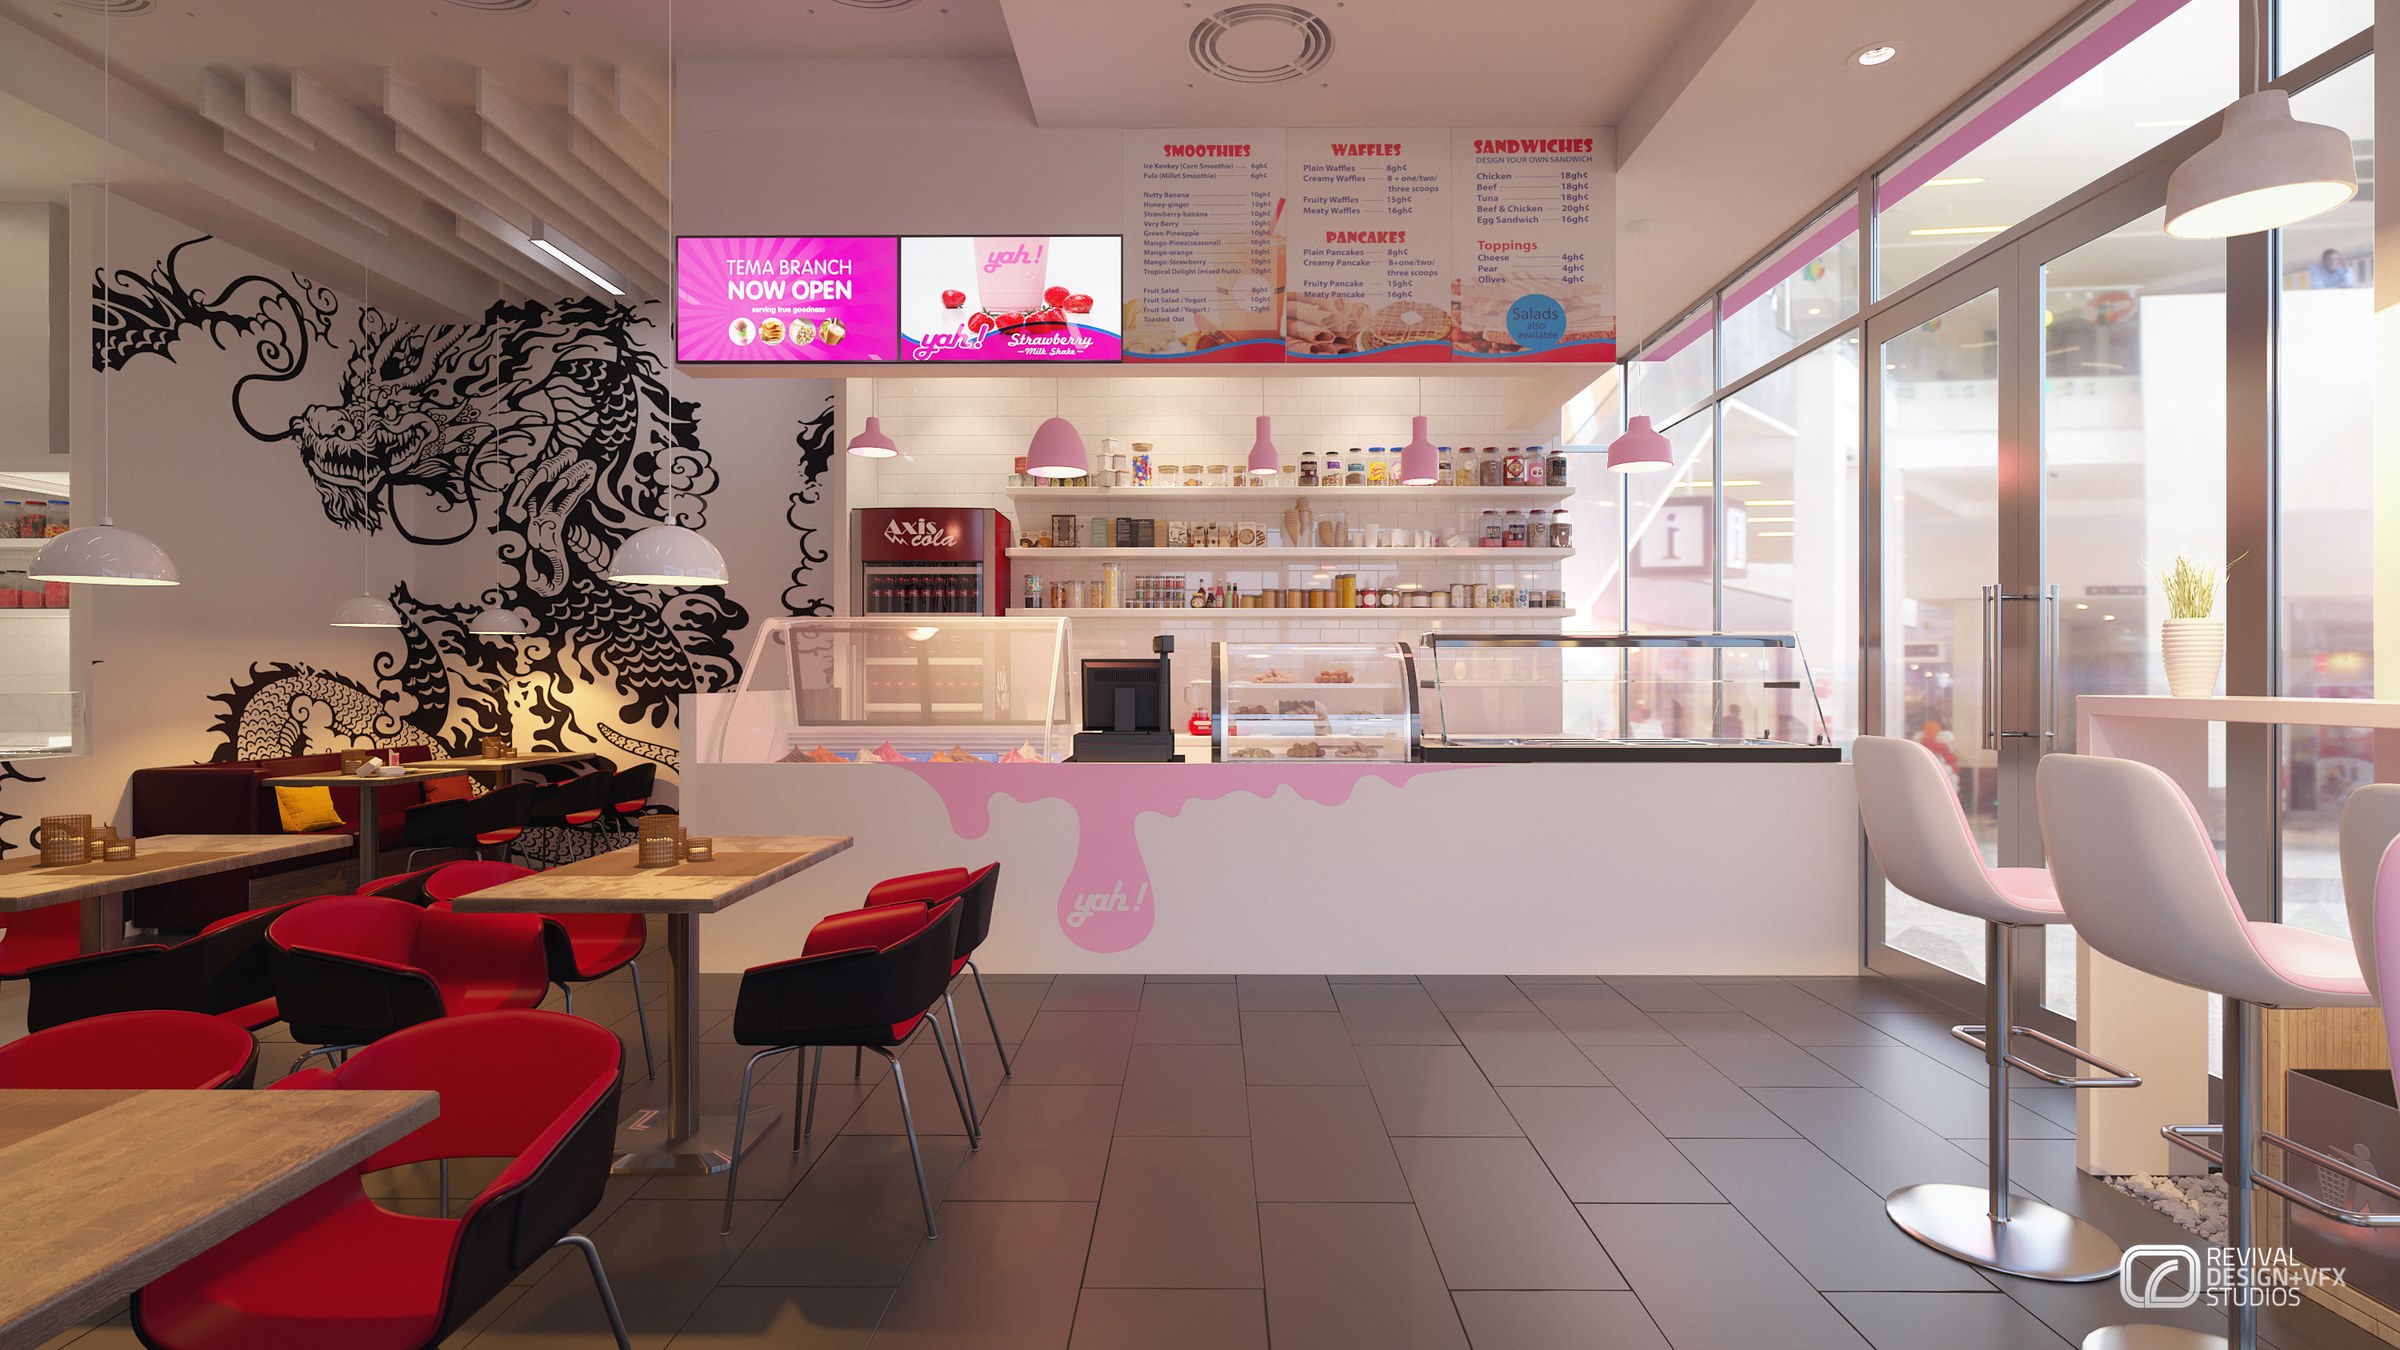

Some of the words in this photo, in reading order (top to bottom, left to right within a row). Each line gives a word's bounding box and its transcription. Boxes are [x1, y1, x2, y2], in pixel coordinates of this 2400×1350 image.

[1164, 144, 1251, 157] SMOOTHIES
[1331, 144, 1401, 156] WAFFLES
[1474, 139, 1593, 154] SANDWICHES
[1303, 175, 1334, 184] Creamy
[1303, 197, 1327, 205] Fruity
[1303, 208, 1329, 216] Meaty
[1478, 217, 1494, 225] Egg
[1496, 216, 1538, 224] Sandwich
[1326, 231, 1405, 243] PANCAKES
[1478, 240, 1537, 252] Toppings
[726, 259, 774, 275] TEMA
[780, 259, 852, 275] BRANCH
[1303, 260, 1334, 268] Creamy
[1304, 280, 1328, 288] Fruity
[1478, 276, 1505, 284] Olives
[728, 280, 786, 300] NOW
[792, 280, 852, 300] OPEN
[1304, 291, 1329, 299] Meaty
[752, 306, 776, 314] serving
[793, 306, 826, 314] goodness
[1512, 308, 1558, 320] Salads
[1527, 322, 1545, 330] also
[1008, 333, 1093, 346] Strawberry
[1517, 331, 1558, 339] available
[911, 528, 957, 547] cola
